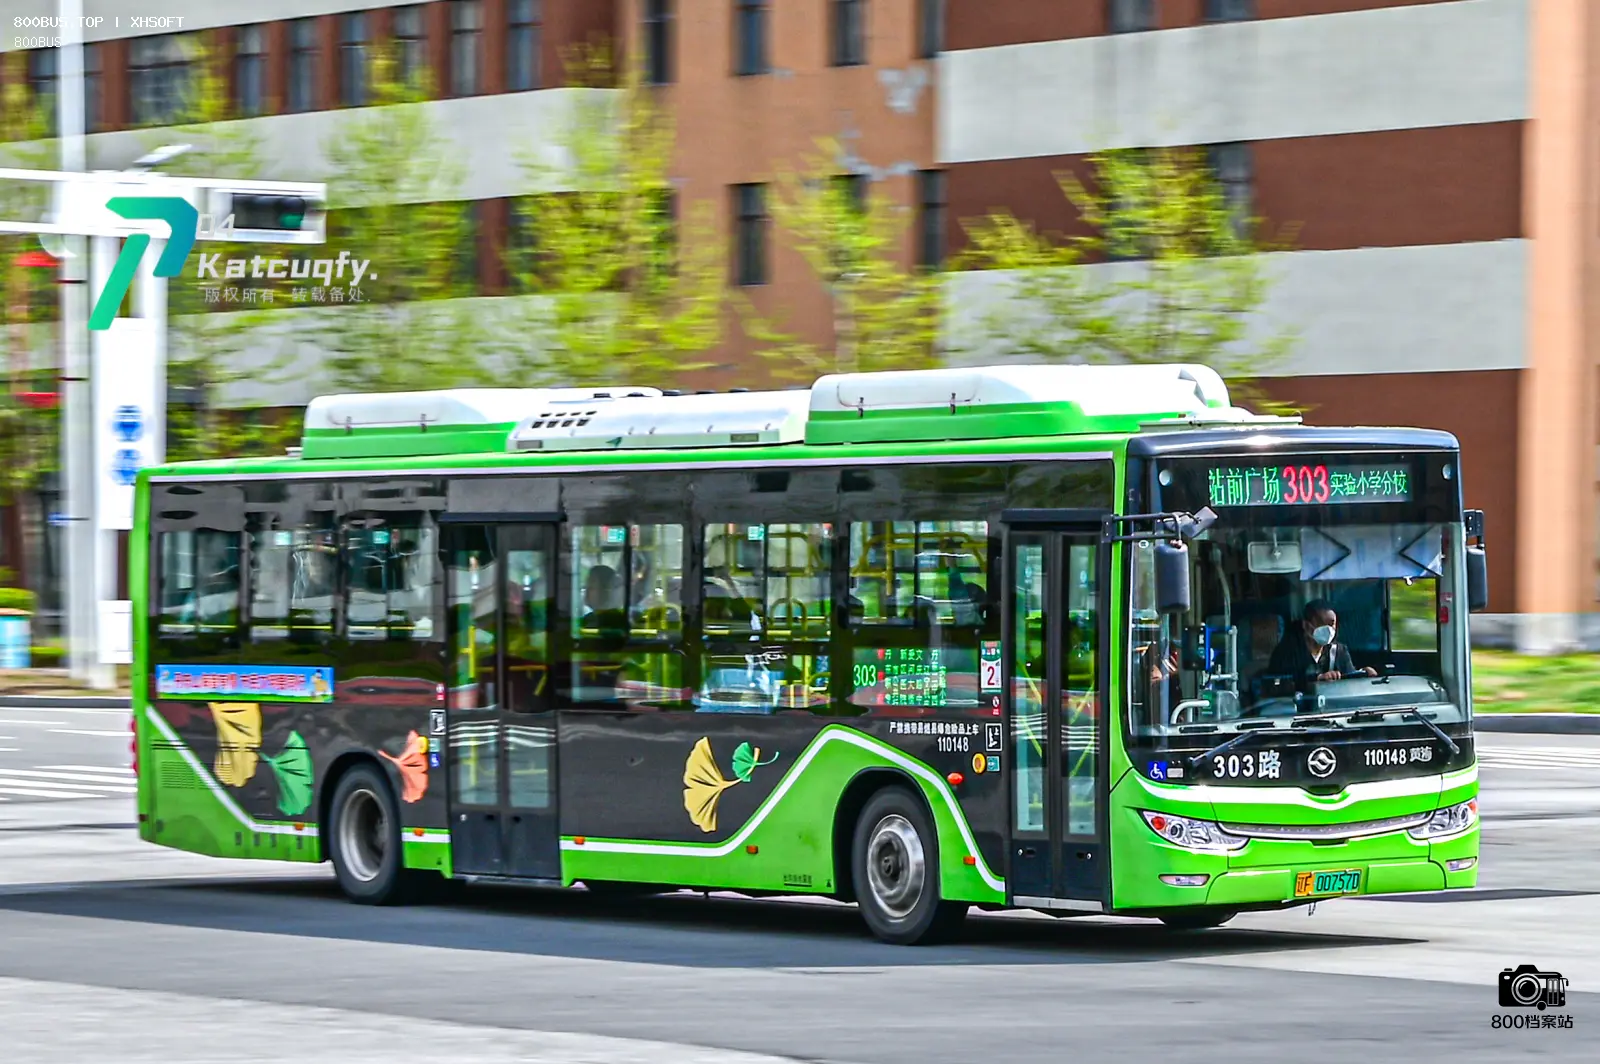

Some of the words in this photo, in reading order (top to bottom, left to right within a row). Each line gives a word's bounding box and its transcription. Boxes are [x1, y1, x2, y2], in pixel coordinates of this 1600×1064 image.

[1208, 466, 1280, 505] 站前广场
[1282, 464, 1330, 504] 303
[1330, 469, 1408, 497] 实验小学分校
[853, 664, 877, 688] 303
[987, 665, 995, 686] 2
[937, 736, 970, 753] 110148
[1213, 749, 1282, 780] 303路
[1363, 748, 1407, 766] 110148
